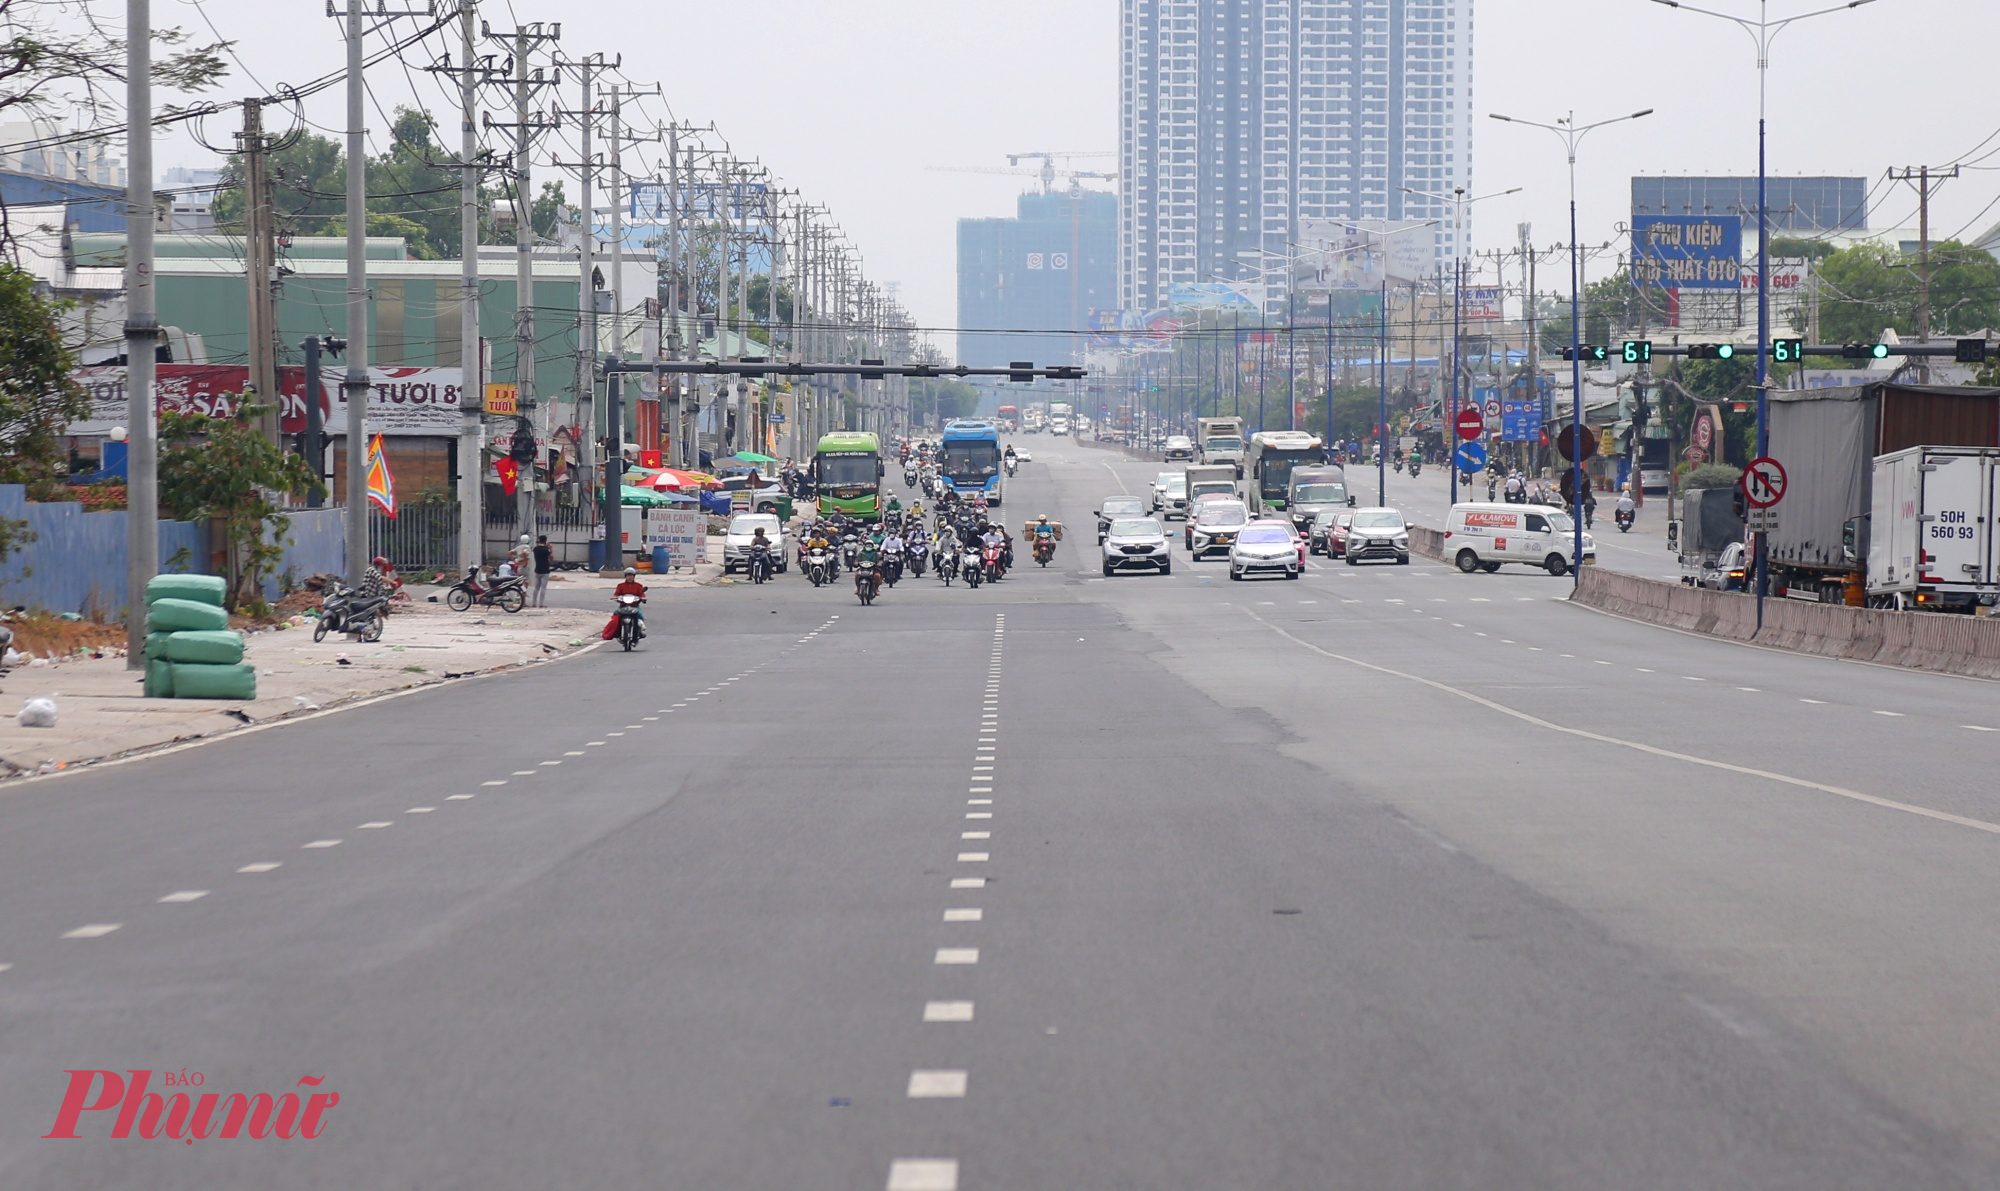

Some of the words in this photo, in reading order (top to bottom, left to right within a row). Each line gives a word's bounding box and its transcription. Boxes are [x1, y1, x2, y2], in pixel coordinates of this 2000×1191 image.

[1650, 222, 1681, 250] PHỤ
[1686, 220, 1722, 250] KIỆN
[1635, 255, 1661, 284] NỘI
[1667, 252, 1703, 280] THẤT
[1708, 255, 1737, 282] ÔTÔ
[1624, 341, 1650, 361] 61
[1775, 341, 1799, 360] 61
[376, 382, 437, 404] TƯƠI
[650, 511, 671, 522] BÁNH
[673, 513, 694, 523] CANH
[1474, 514, 1517, 523] LALAMOVE
[1940, 511, 1965, 523] 50H
[658, 523, 669, 534] CÁ
